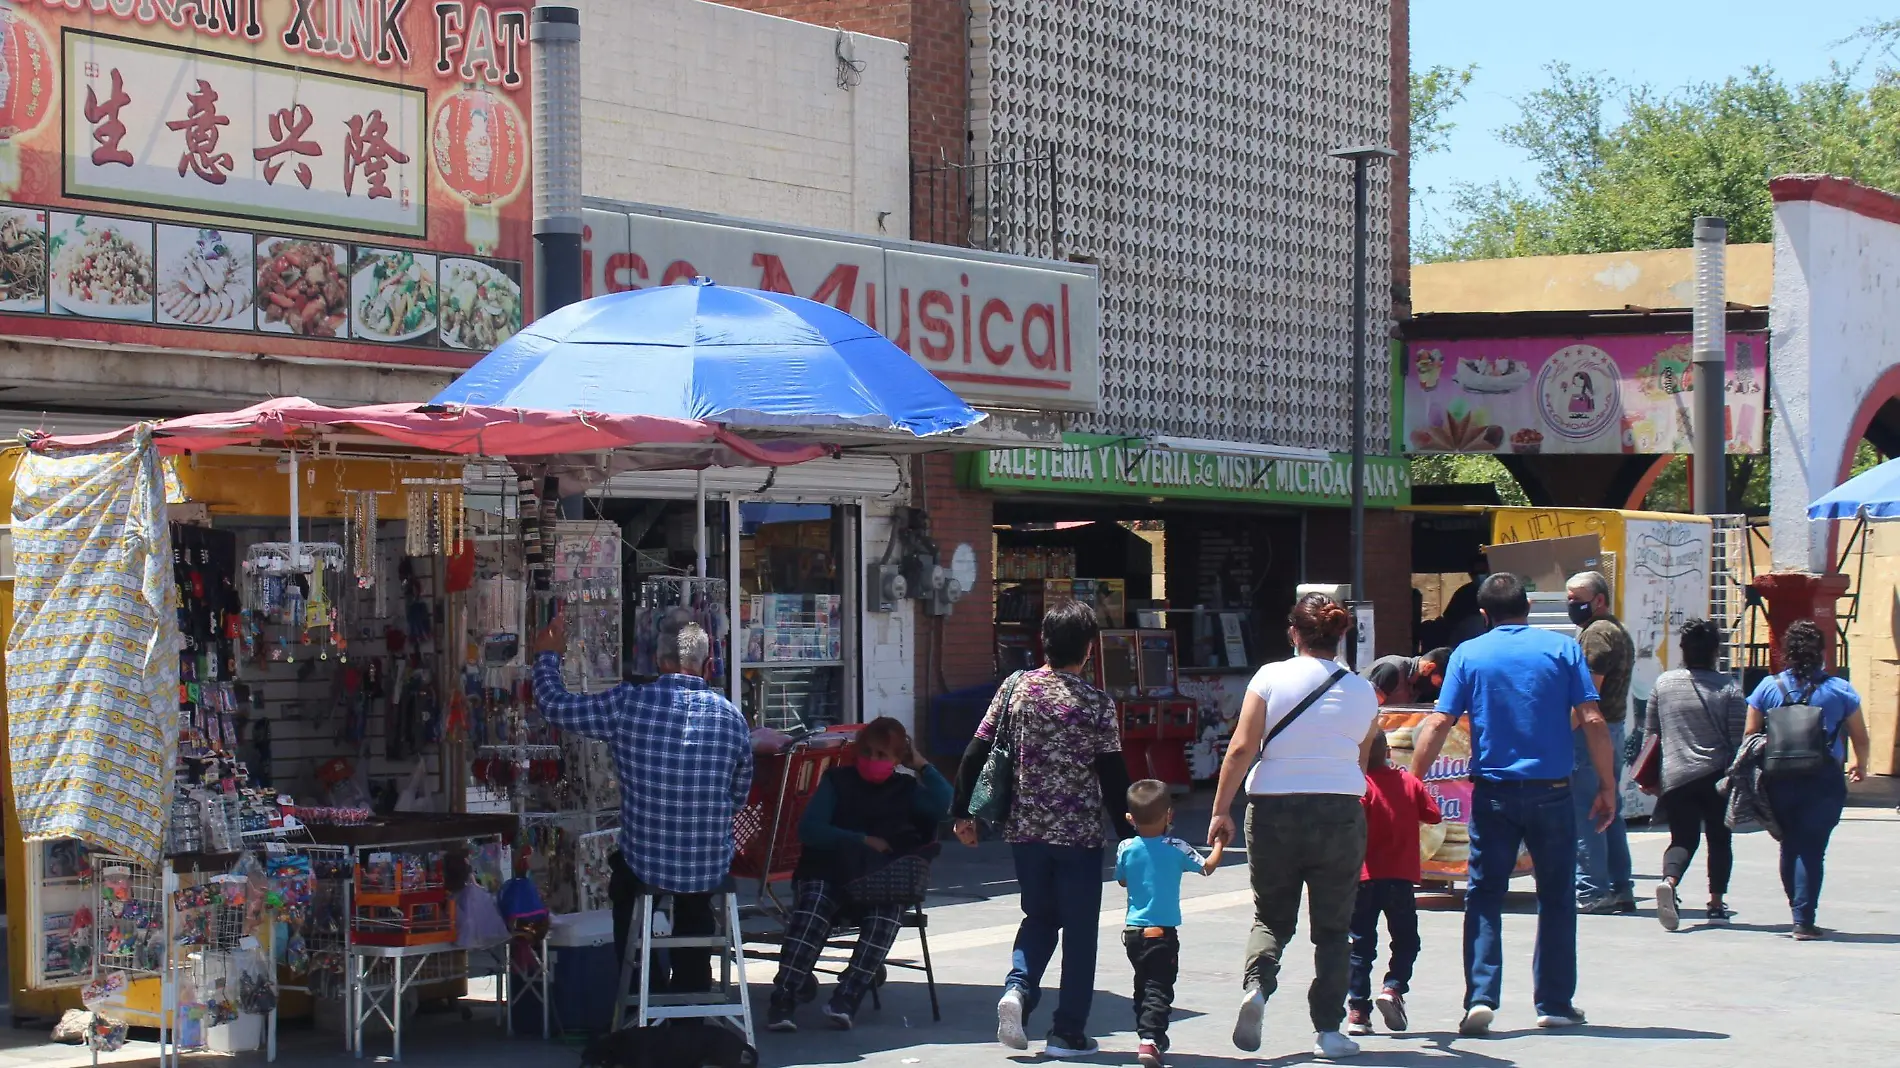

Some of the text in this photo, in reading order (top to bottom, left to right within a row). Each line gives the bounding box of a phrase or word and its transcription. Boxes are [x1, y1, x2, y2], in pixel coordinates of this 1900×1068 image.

[283, 0, 411, 65] XINK
[434, 3, 526, 88] FAT
[752, 253, 1072, 375] Musical
[1098, 446, 1110, 482] Y
[1115, 446, 1192, 486] NEVERIA
[1194, 453, 1214, 487] La
